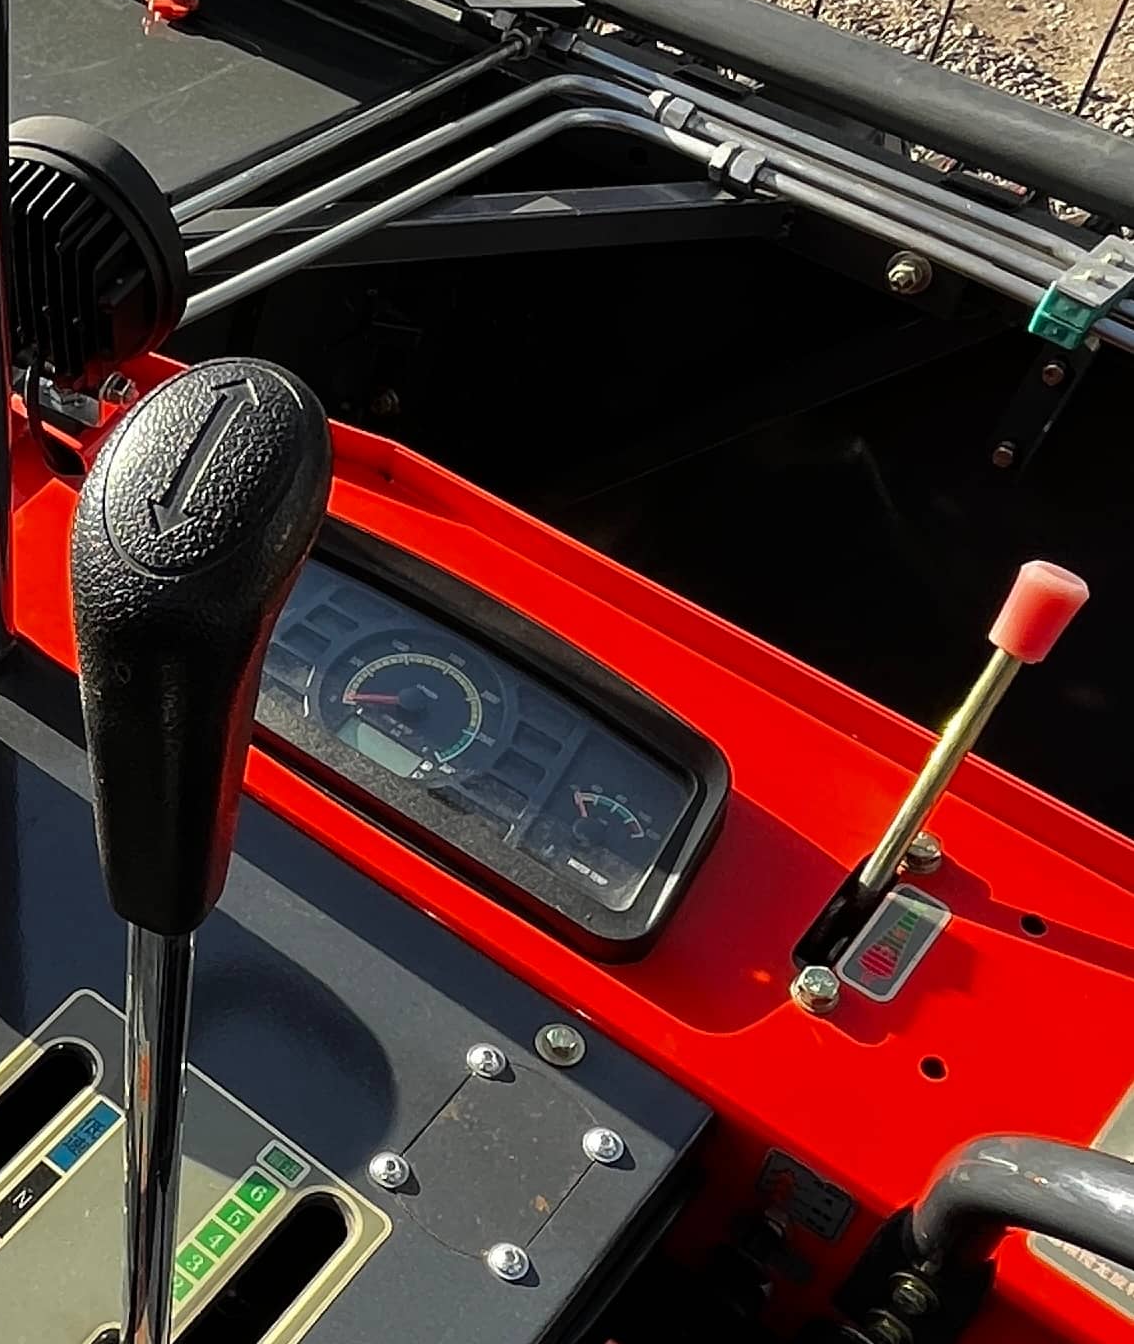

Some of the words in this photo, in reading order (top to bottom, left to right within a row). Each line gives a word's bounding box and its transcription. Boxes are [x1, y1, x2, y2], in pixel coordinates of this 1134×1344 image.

[12, 1189, 33, 1209] N
[250, 1185, 268, 1202] 6
[227, 1210, 245, 1226] 5
[209, 1233, 225, 1249] 4
[186, 1254, 204, 1272] 3
